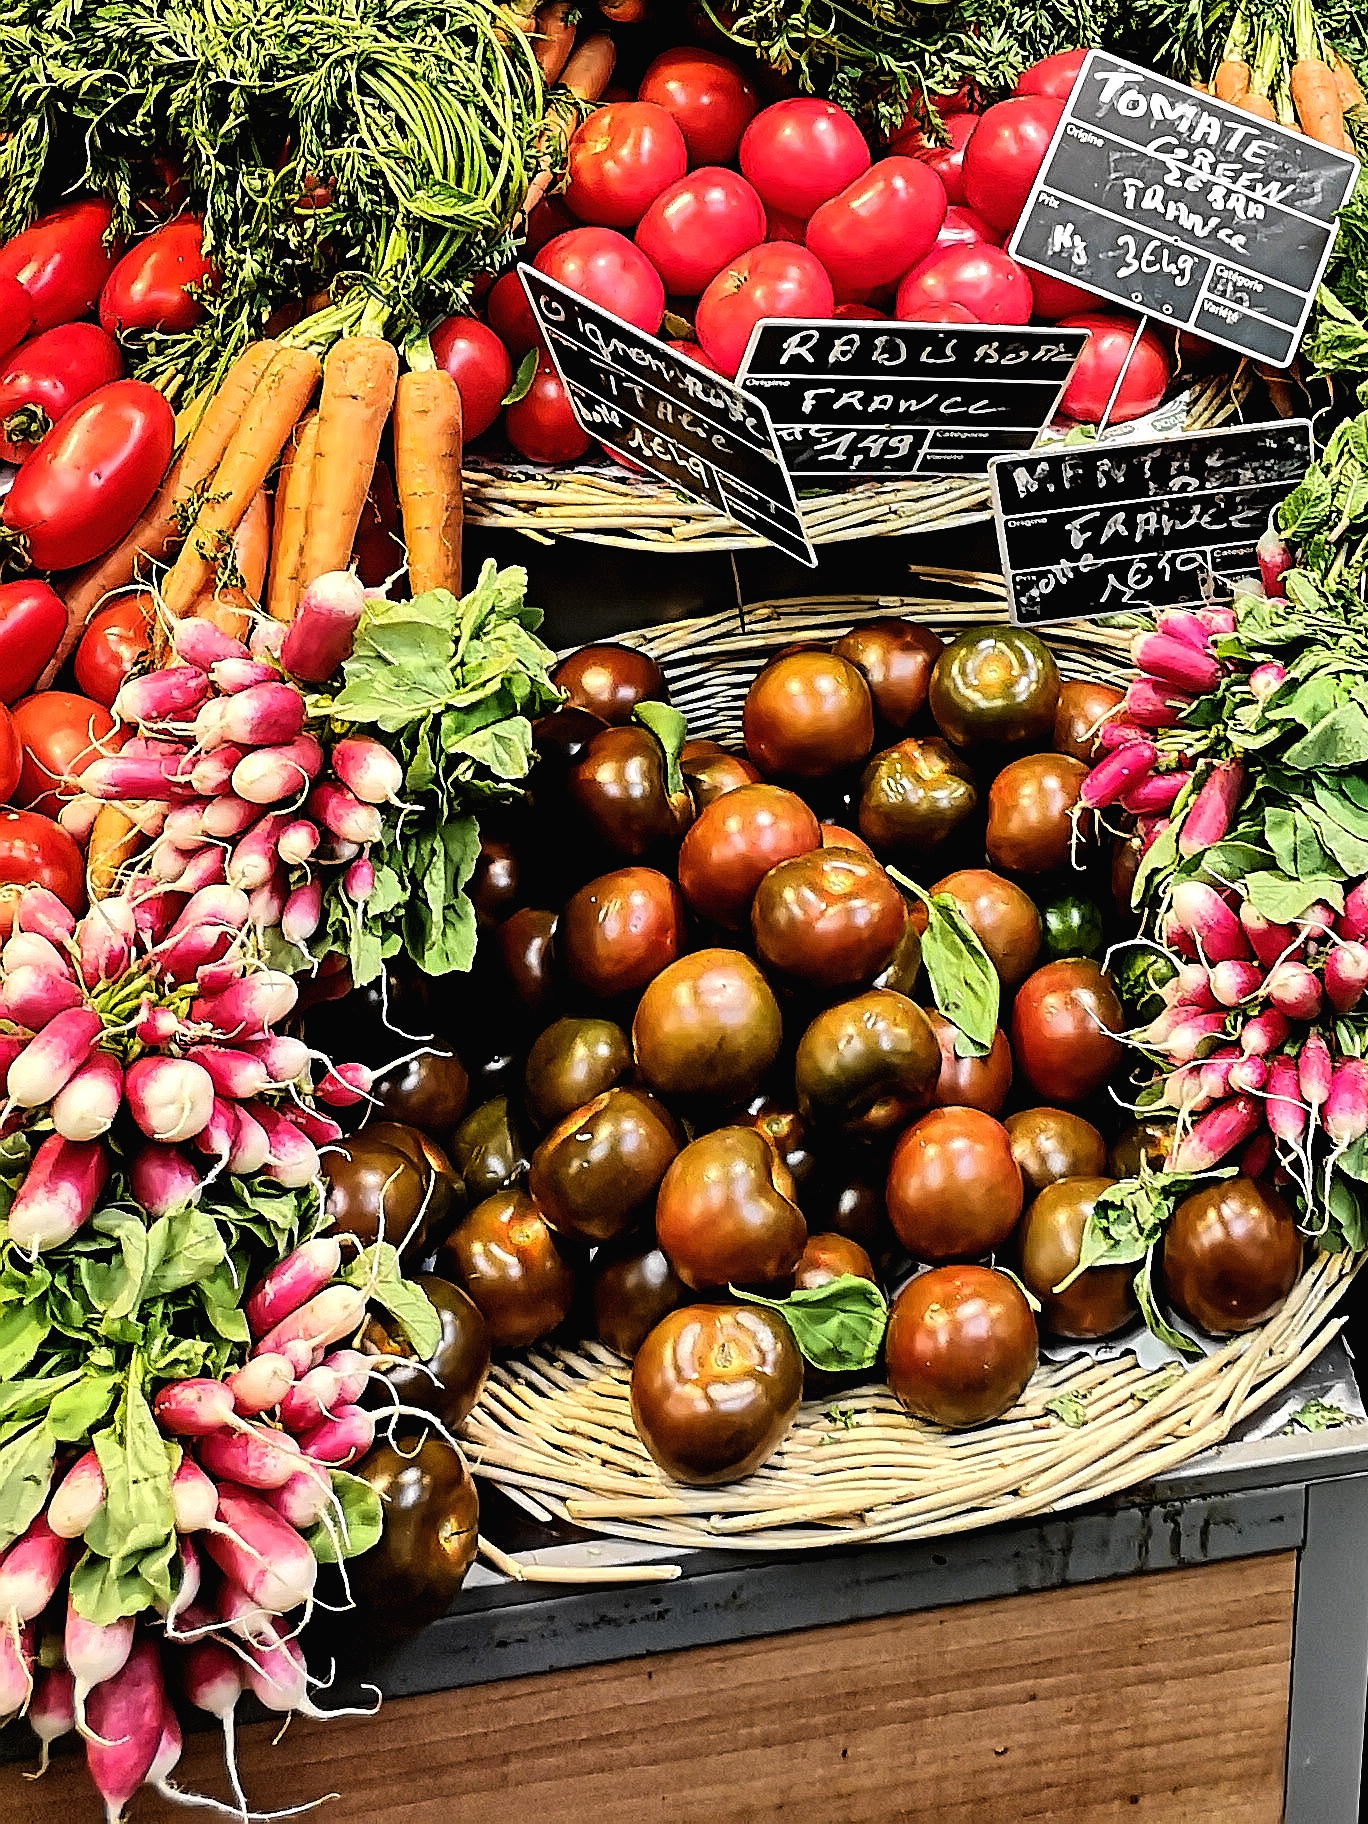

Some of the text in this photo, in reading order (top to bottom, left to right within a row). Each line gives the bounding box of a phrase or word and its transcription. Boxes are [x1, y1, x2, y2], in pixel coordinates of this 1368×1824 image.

[1094, 71, 1279, 165] TOMATE
[1066, 124, 1104, 148] Origine
[1038, 190, 1060, 209] Prix
[813, 431, 914, 470] 1,49
